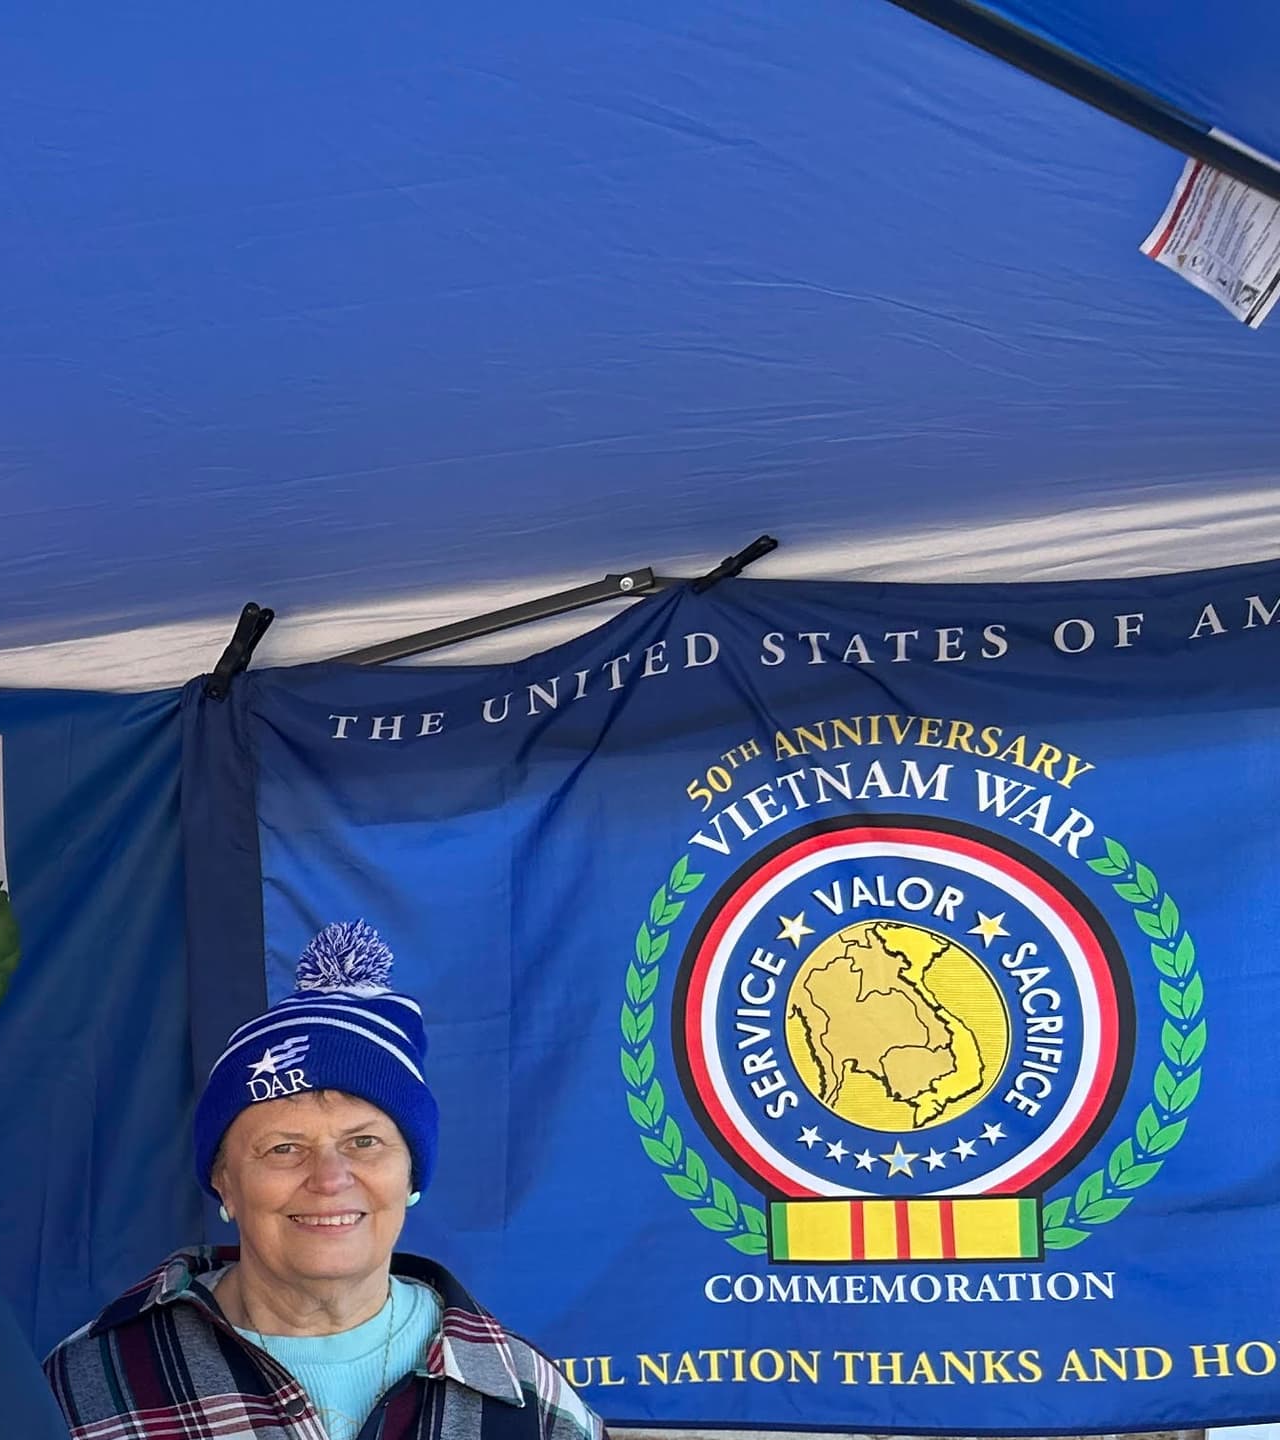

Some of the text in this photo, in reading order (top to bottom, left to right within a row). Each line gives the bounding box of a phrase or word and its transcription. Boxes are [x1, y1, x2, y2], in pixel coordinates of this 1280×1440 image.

[327, 711, 445, 741] THE
[482, 632, 721, 723] UNITED
[760, 624, 1009, 666] STATES
[1053, 613, 1144, 654] OF
[686, 714, 1096, 813] 50TH ANNIVERSARY
[688, 759, 1096, 860] VIETNAM WAR
[813, 876, 966, 922] VALOR
[736, 946, 800, 1120] SERVICE
[1002, 941, 1065, 1118] SACRIFICE
[246, 1068, 313, 1102] DAR
[704, 1271, 1116, 1304] COMMEMORATION
[637, 1349, 821, 1386] NATION
[834, 1349, 1043, 1386] THANKS
[1057, 1346, 1174, 1383] AND
